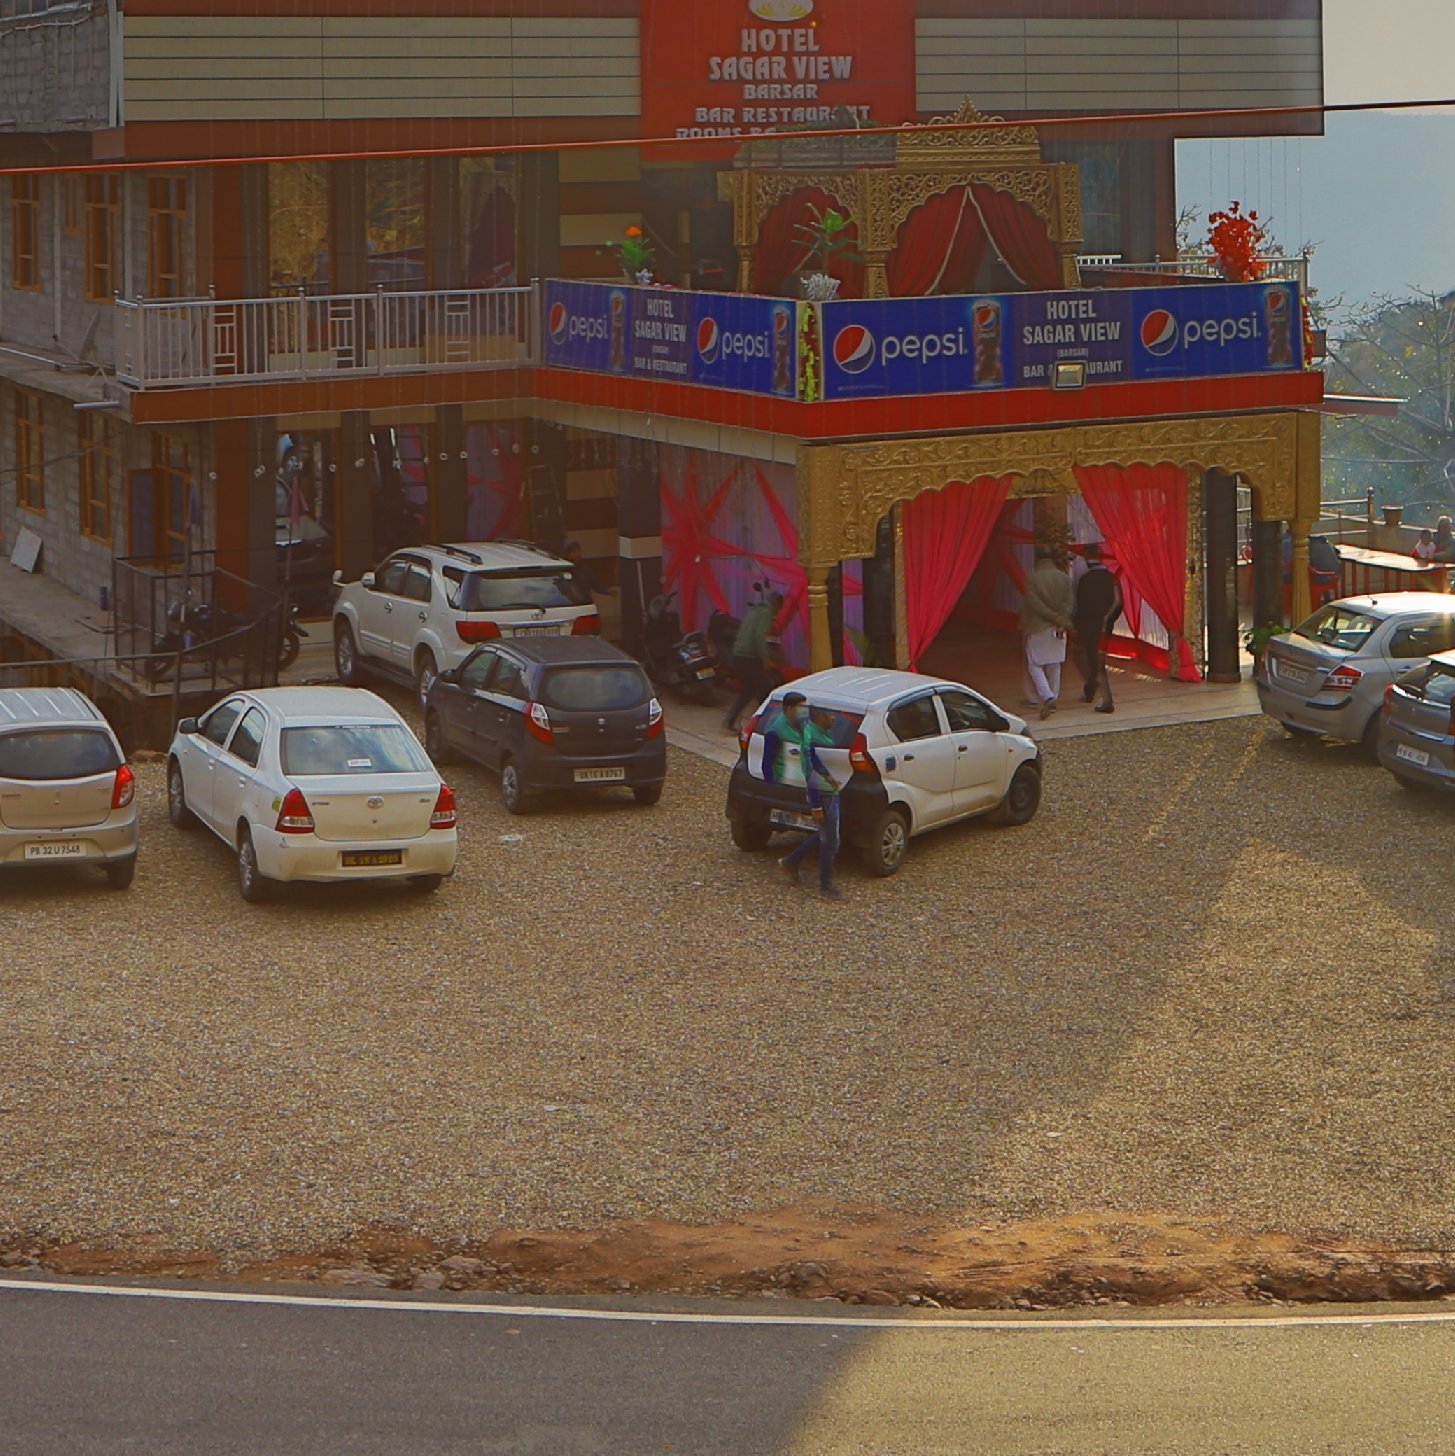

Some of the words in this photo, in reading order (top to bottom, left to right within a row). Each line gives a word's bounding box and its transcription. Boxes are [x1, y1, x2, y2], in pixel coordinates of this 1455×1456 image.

[741, 28, 820, 53] HOTEL
[708, 56, 787, 81] SAGAR
[792, 55, 853, 80] VIEW
[744, 83, 818, 100] BARSAR
[695, 107, 735, 123] BAR
[743, 105, 870, 123] RESTAURNT
[647, 298, 674, 319] HOTEL
[1046, 299, 1097, 320] HOTEL
[569, 315, 608, 343] pepsi
[634, 319, 663, 340] SAGAR
[664, 322, 688, 342] VIEW
[1023, 324, 1075, 345] SAGAR
[1080, 321, 1121, 342] VIEW
[1184, 311, 1259, 349] pepsi
[722, 332, 770, 363] pepsi
[882, 327, 966, 367] pepsi
[1023, 364, 1045, 378] BAR
[30, 846, 41, 855] PB
[43, 845, 53, 855] 32
[61, 844, 81, 855] 7548
